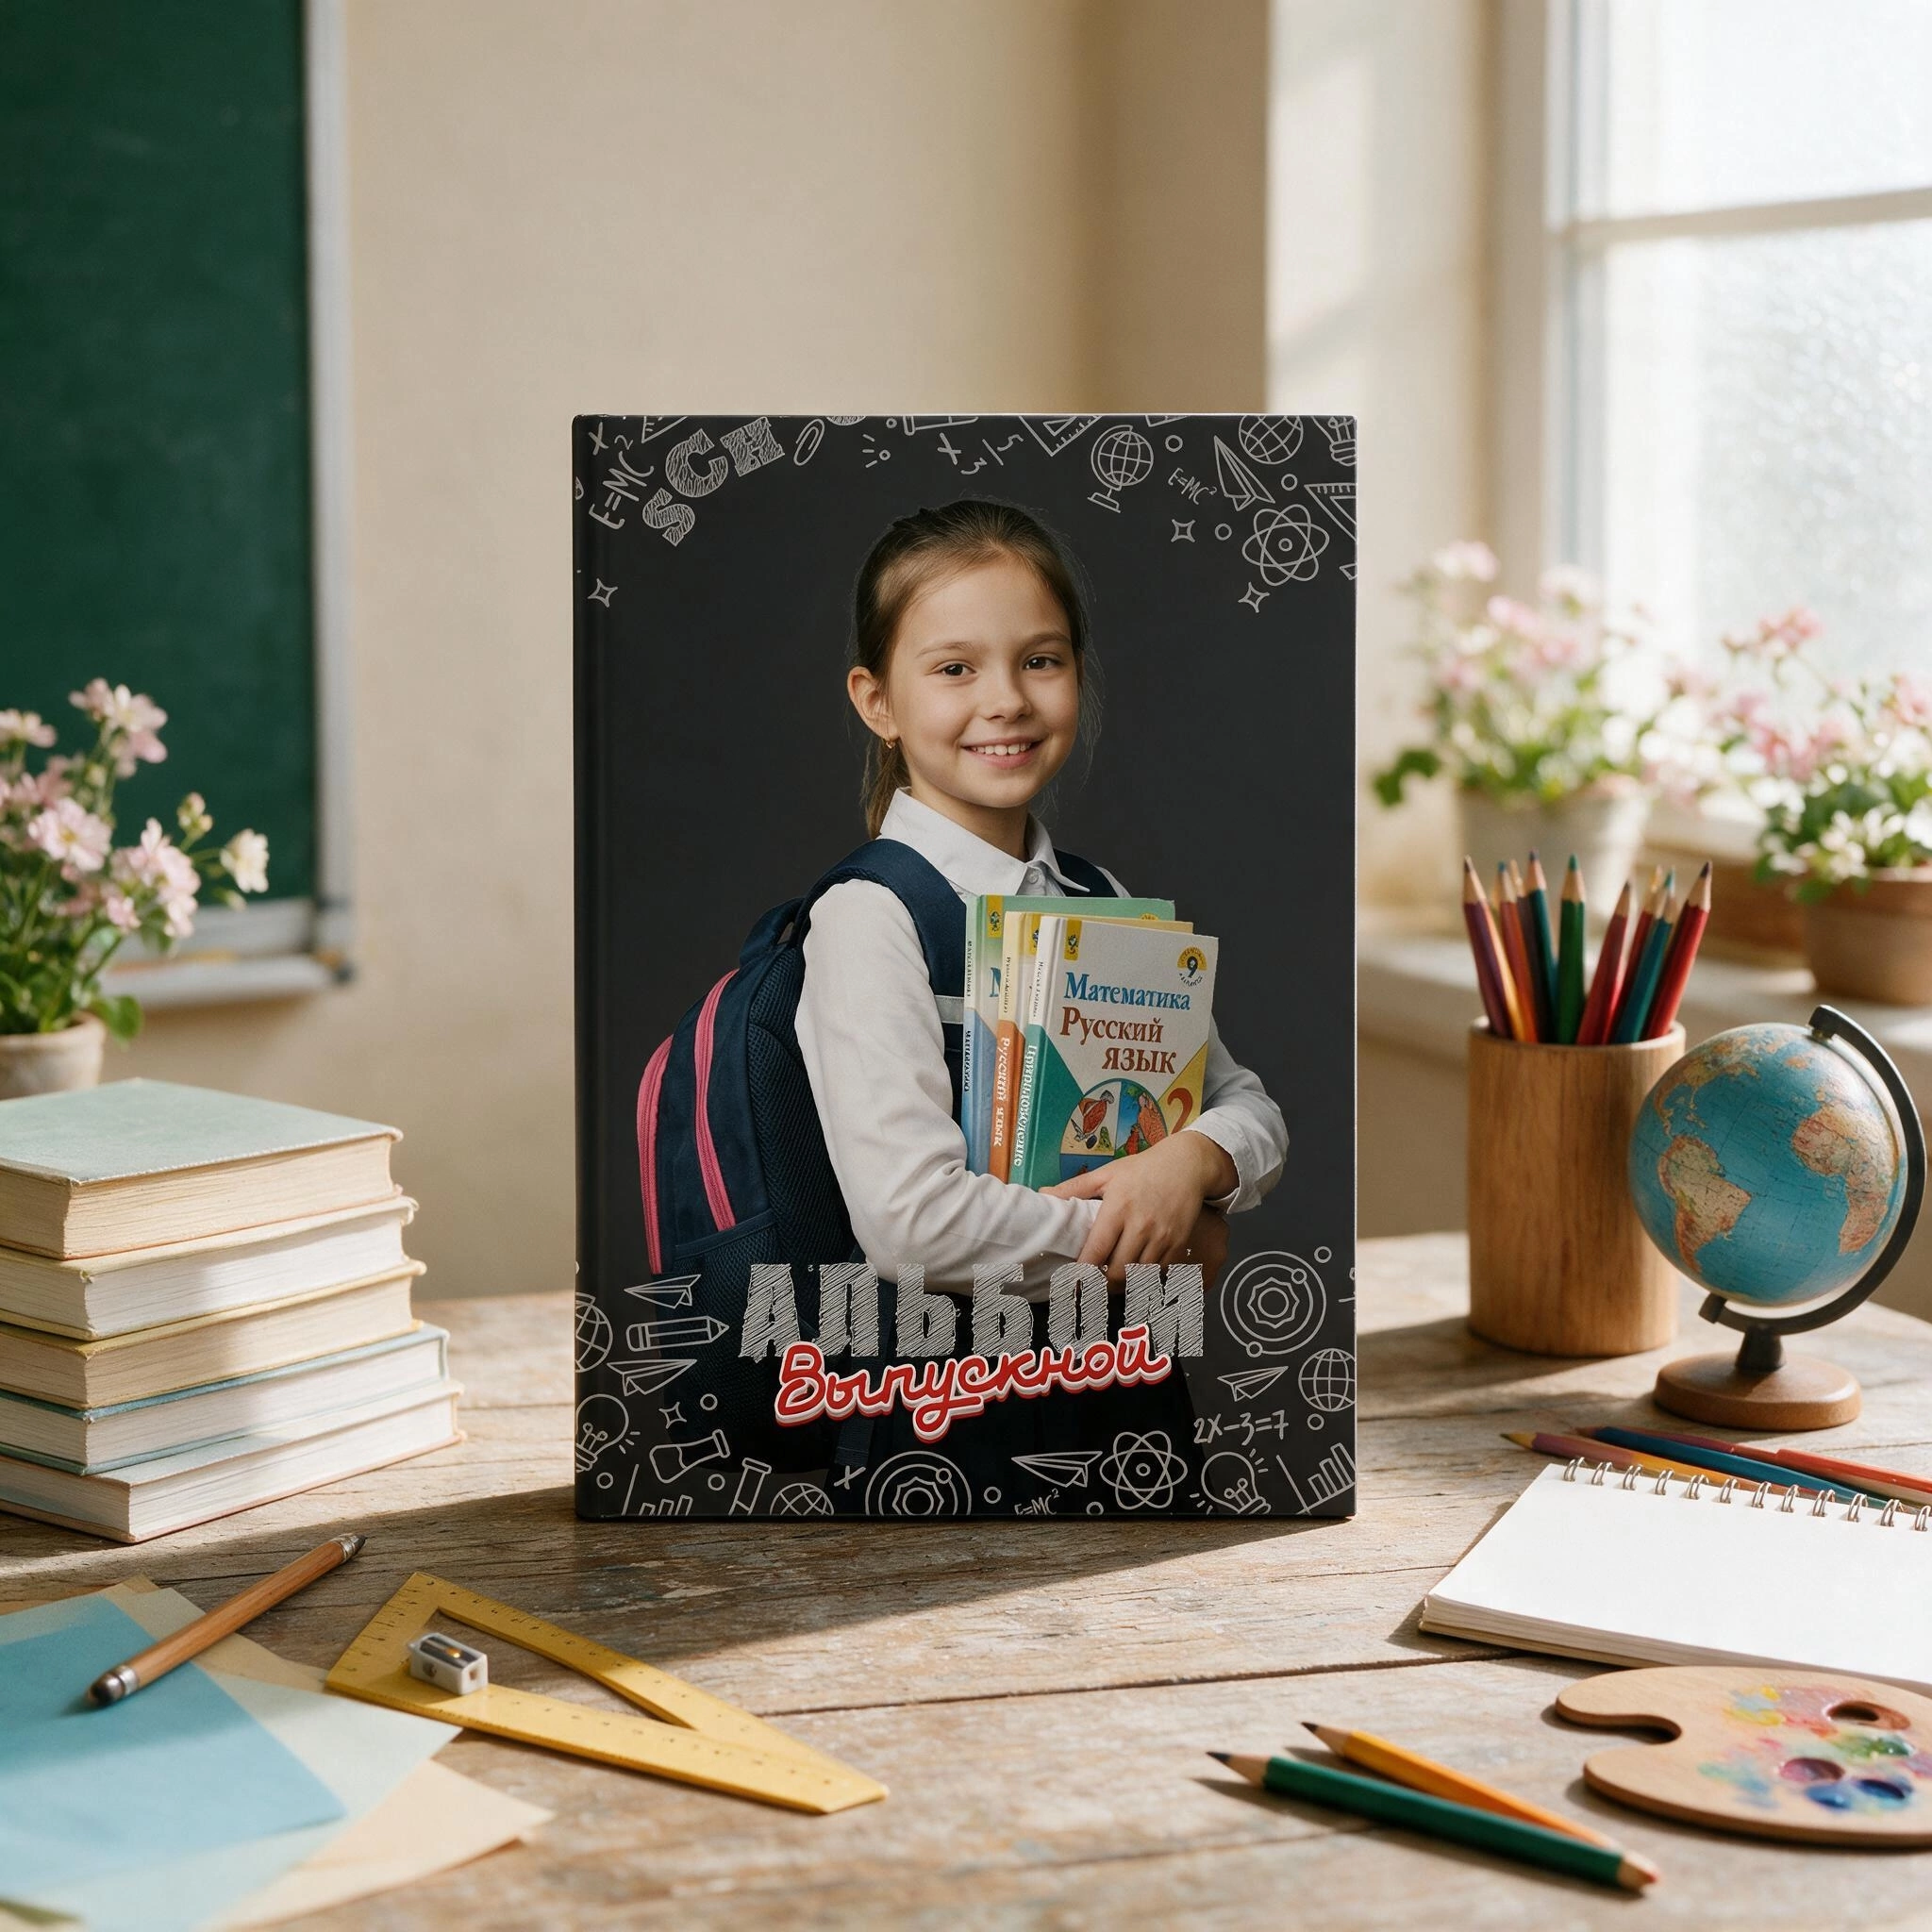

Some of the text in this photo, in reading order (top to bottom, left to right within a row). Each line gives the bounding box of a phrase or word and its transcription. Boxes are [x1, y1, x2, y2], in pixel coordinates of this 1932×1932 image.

[1059, 1006, 1164, 1045] Русский
[1063, 972, 1191, 1010] Математика
[739, 1262, 1205, 1362] АЛЬБОМ
[774, 1323, 1172, 1443] Выпускной
